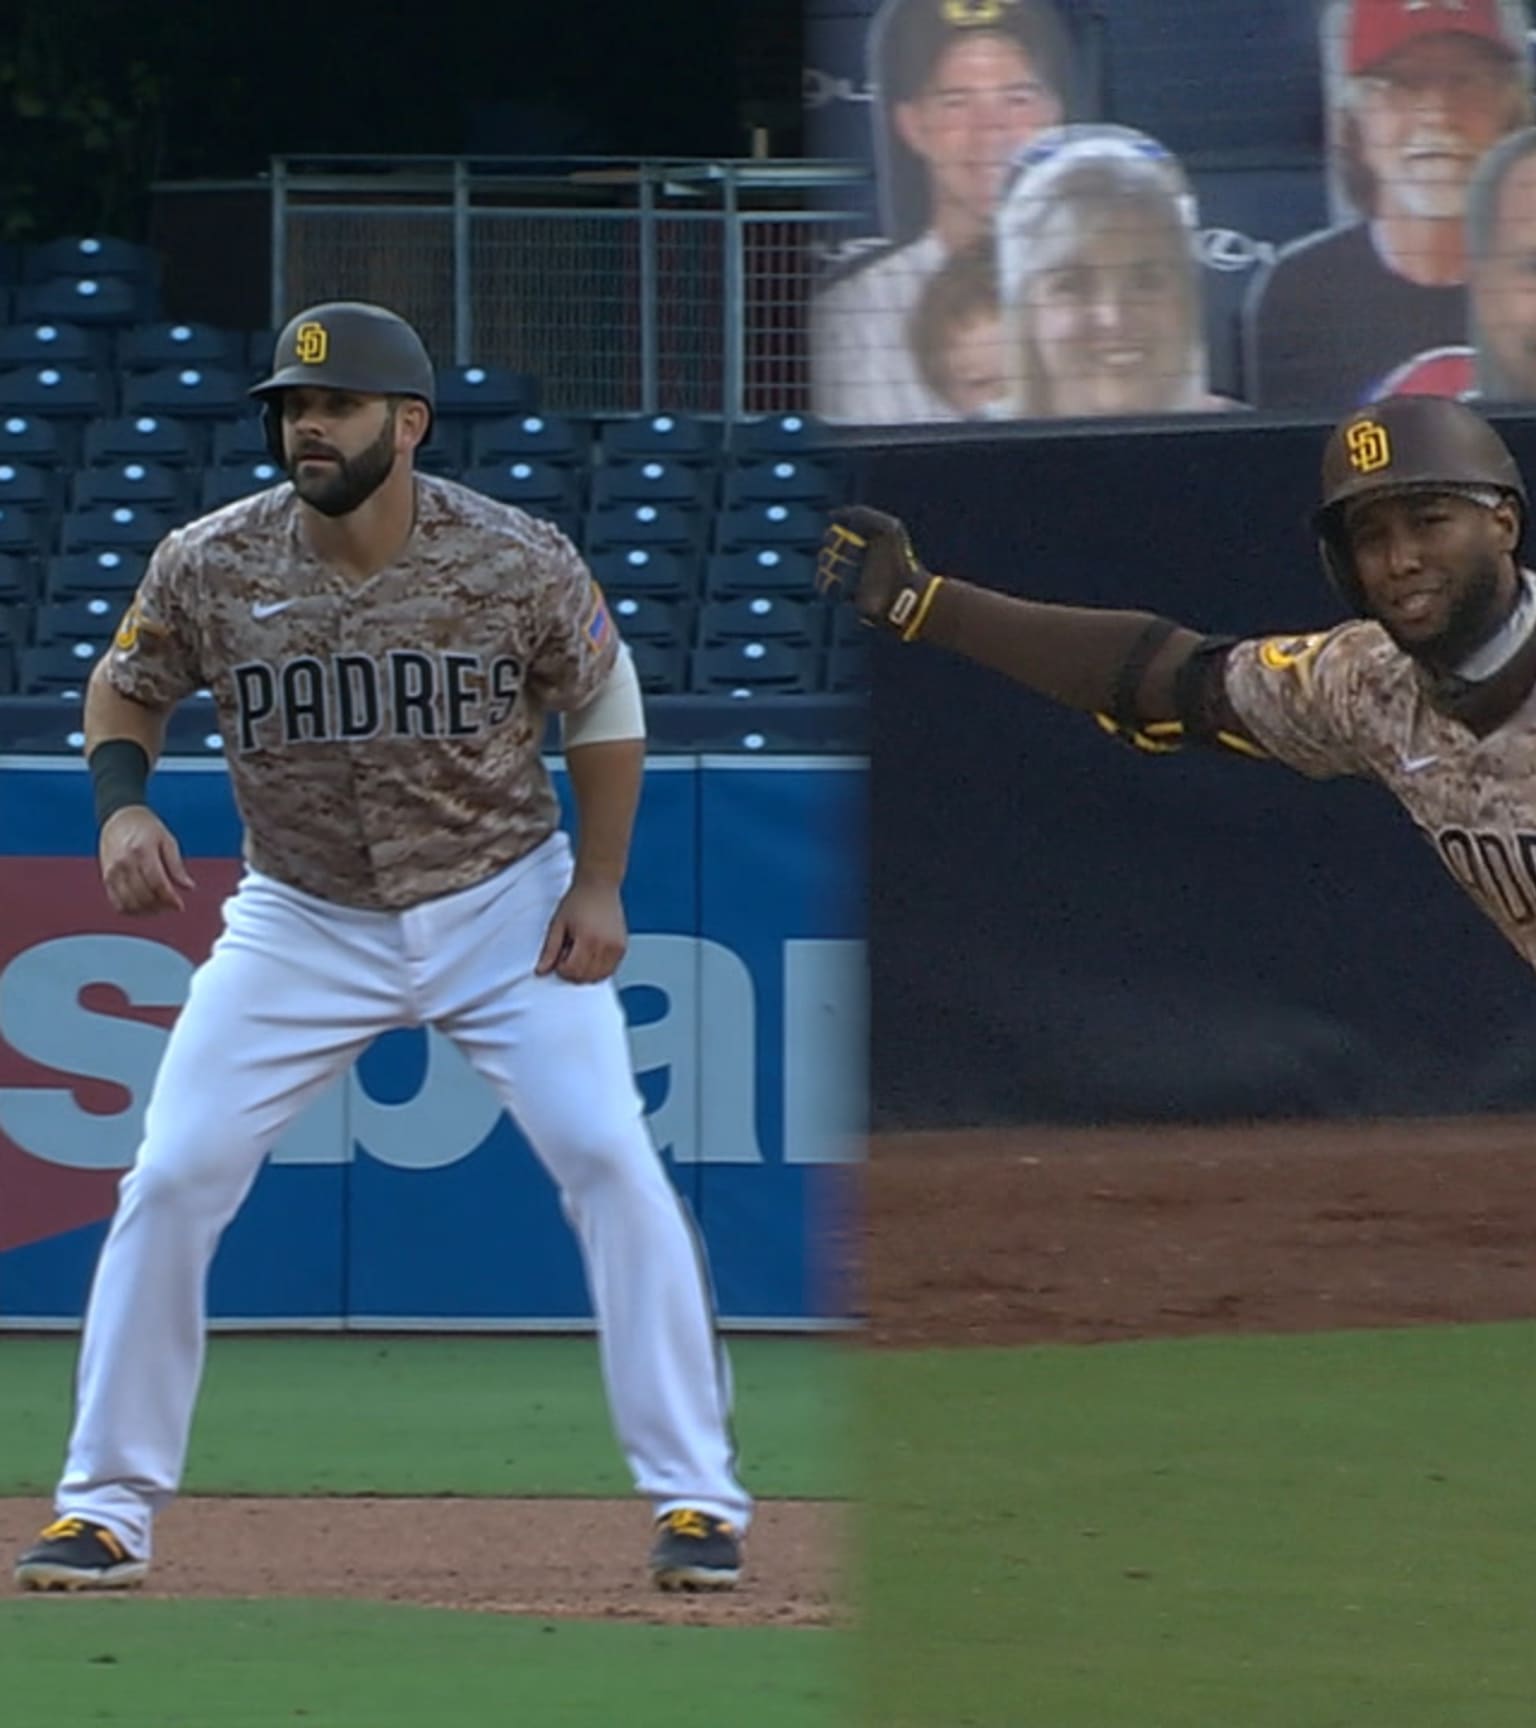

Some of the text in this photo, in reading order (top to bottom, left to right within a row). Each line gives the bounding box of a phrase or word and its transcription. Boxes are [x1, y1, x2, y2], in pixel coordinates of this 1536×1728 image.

[297, 322, 327, 363] SD
[1346, 420, 1390, 472] SD
[234, 651, 523, 753] PADRES
